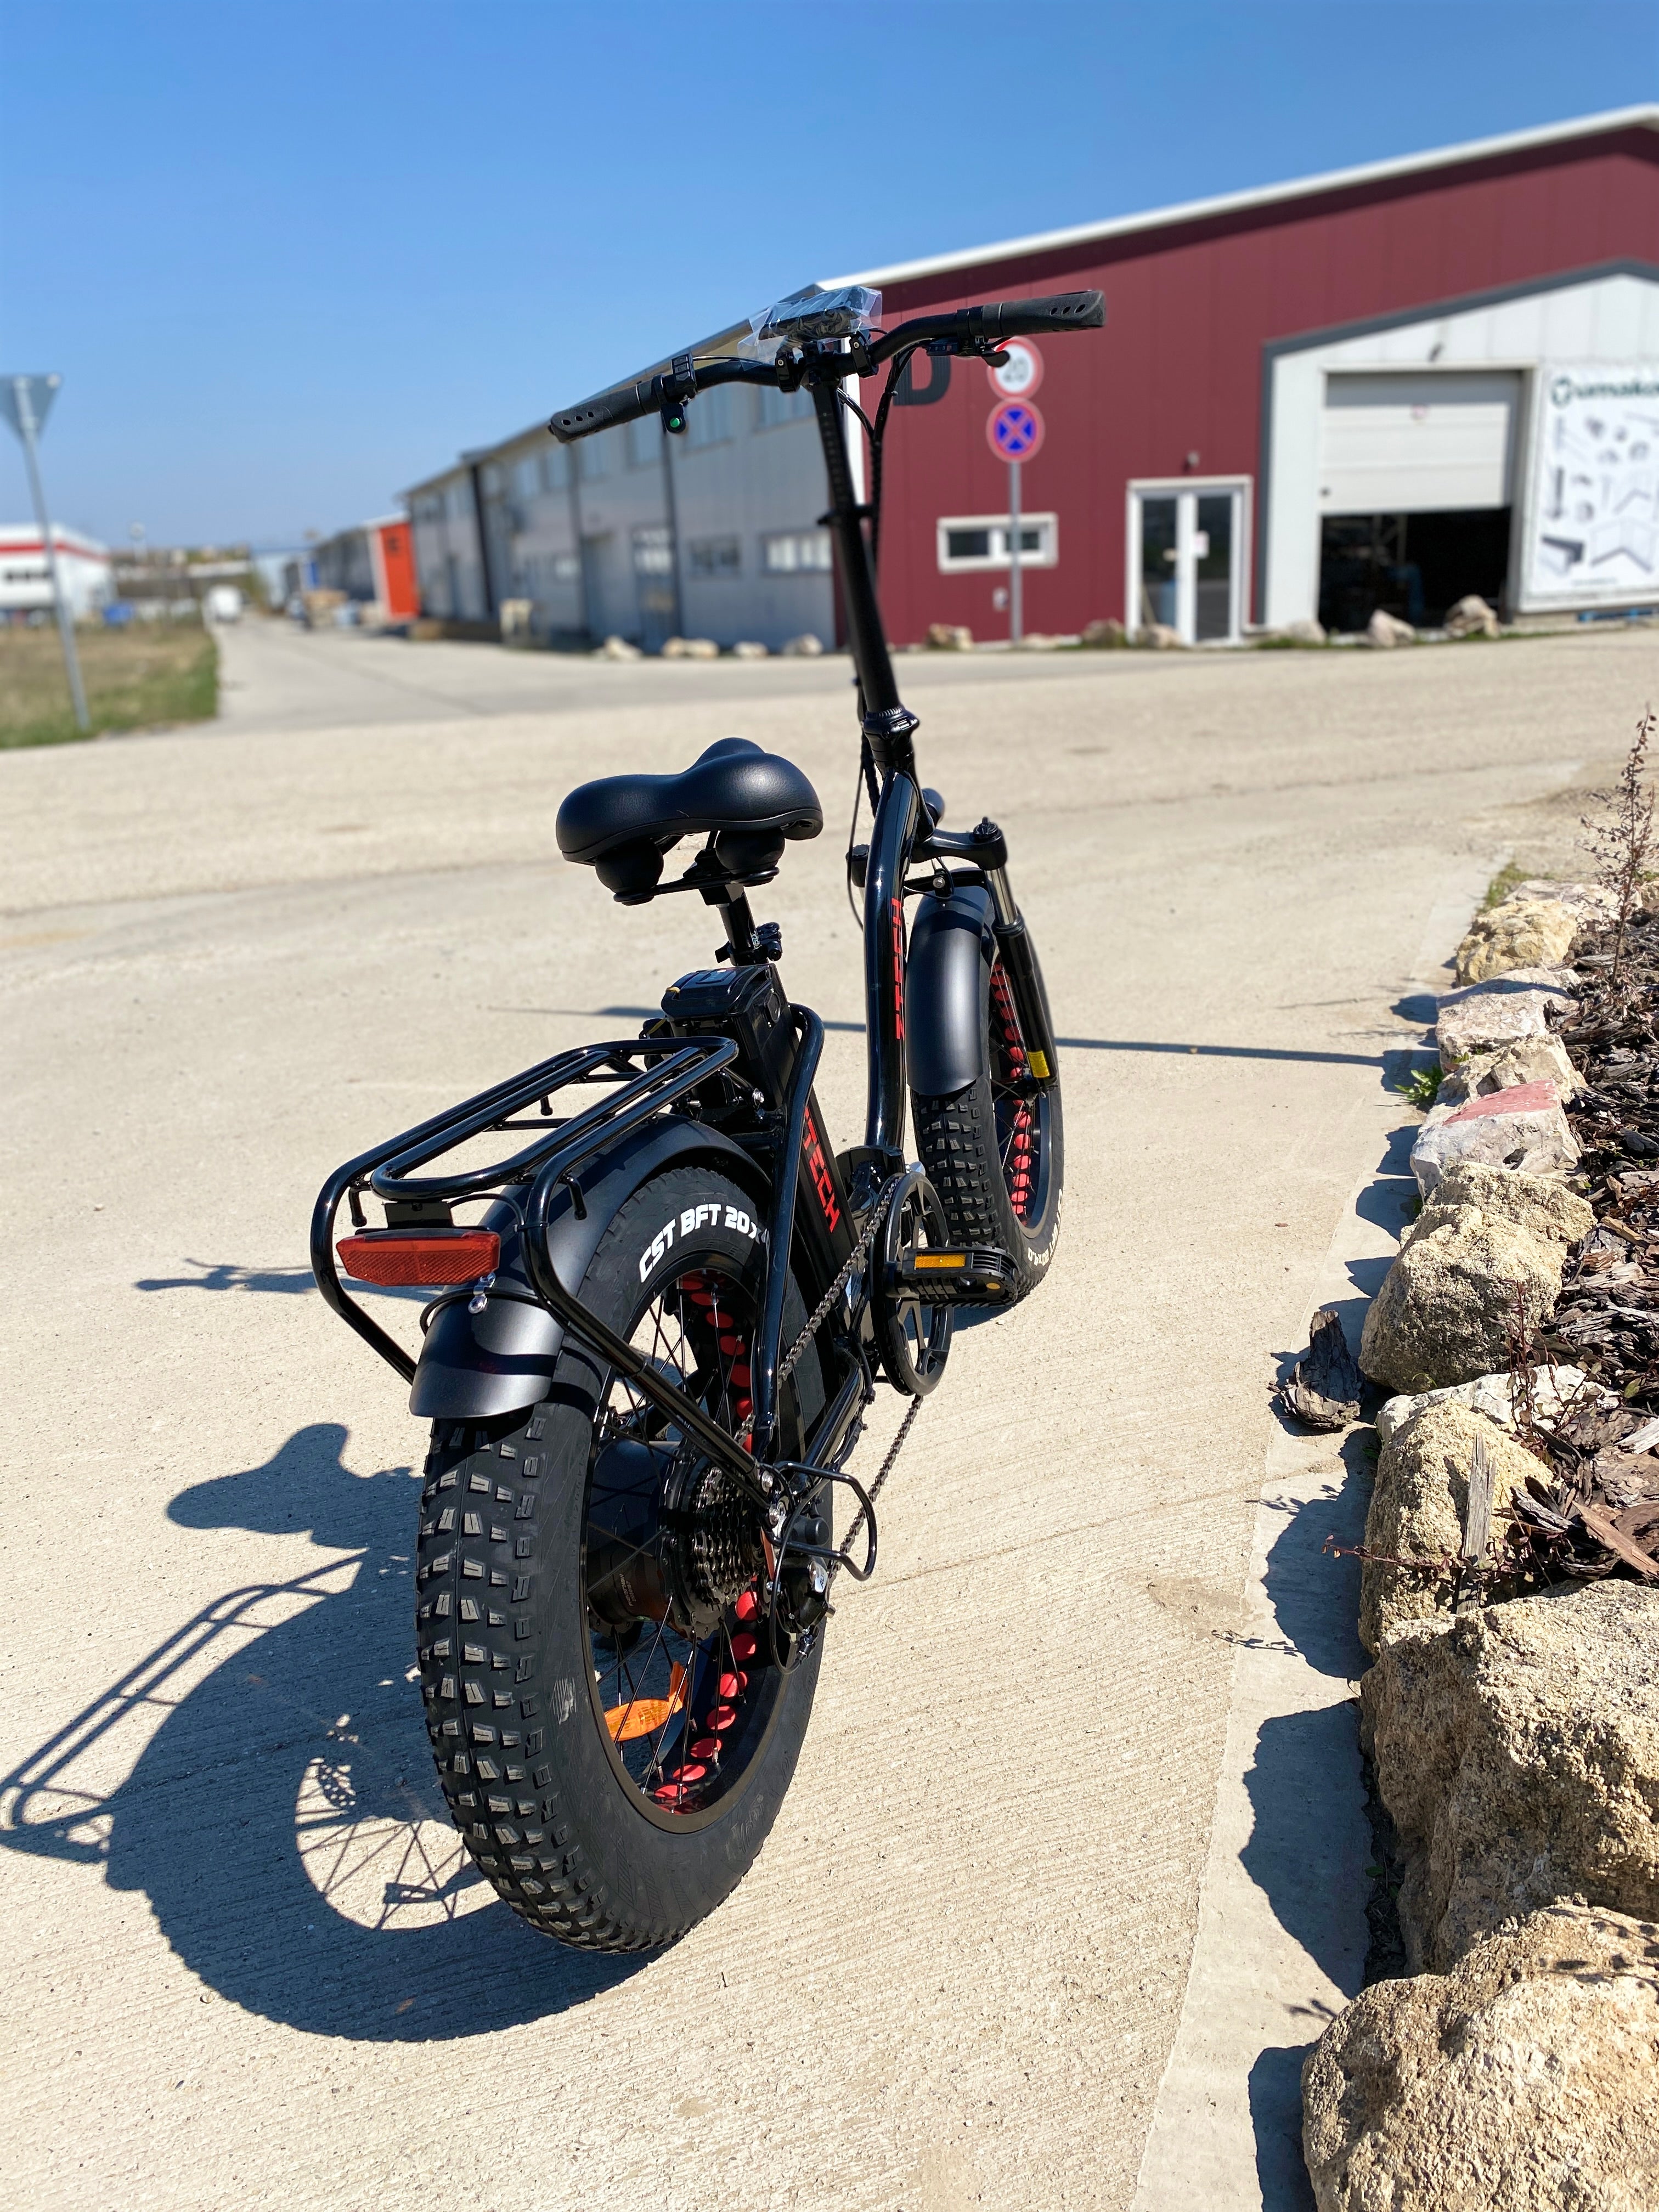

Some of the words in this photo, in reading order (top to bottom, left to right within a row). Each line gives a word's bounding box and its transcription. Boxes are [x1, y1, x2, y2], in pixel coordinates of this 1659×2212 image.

[803, 1107, 840, 1233] TECH
[639, 1218, 677, 1283] CST
[680, 1204, 721, 1238] BFT
